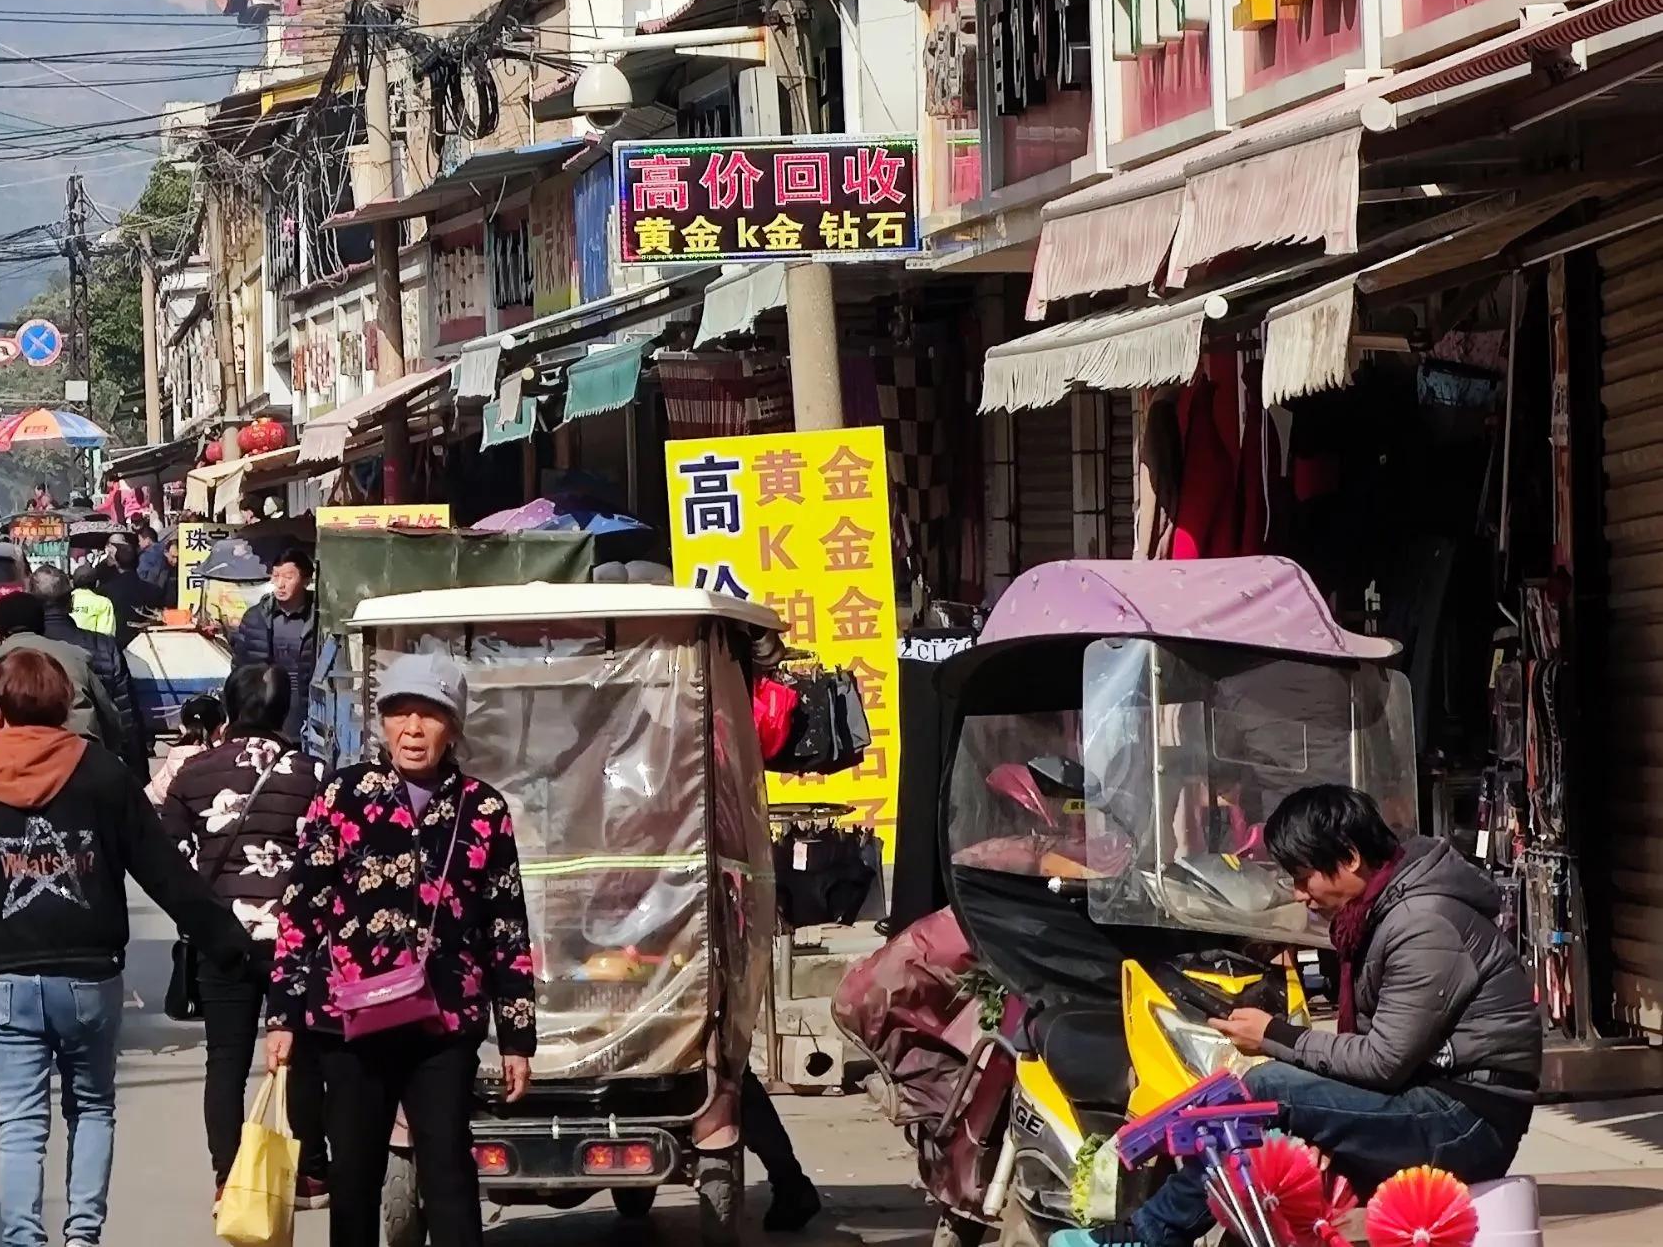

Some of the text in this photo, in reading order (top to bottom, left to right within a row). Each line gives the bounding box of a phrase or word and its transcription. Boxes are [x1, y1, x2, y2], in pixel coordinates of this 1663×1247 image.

[629, 147, 906, 212] 高价回收
[634, 210, 907, 255] 黄金 k金 钻石
[751, 445, 874, 507] 黄金
[758, 515, 875, 572] K金
